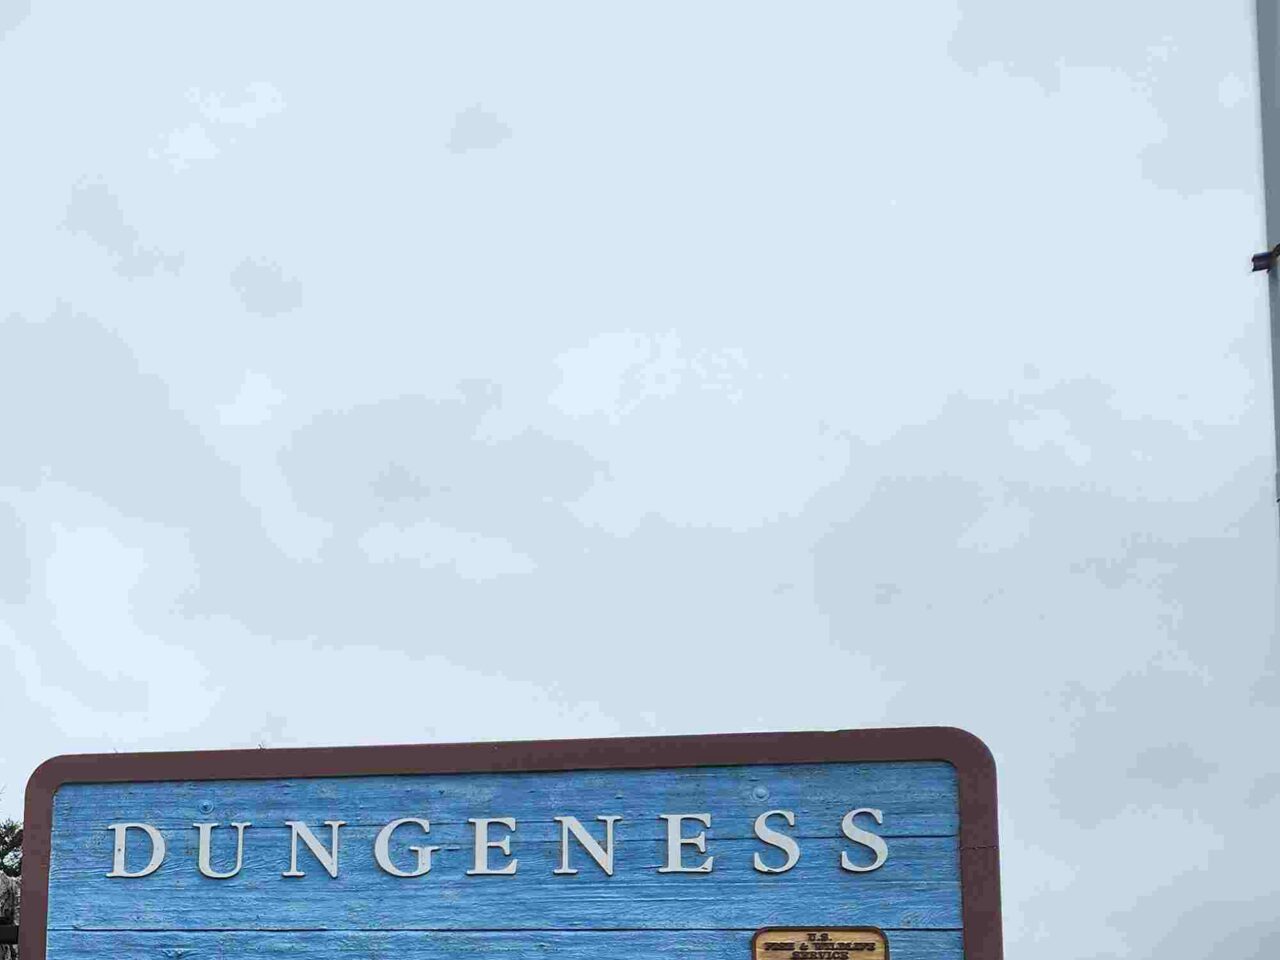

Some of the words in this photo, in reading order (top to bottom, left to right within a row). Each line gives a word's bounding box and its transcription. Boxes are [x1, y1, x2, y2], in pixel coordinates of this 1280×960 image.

[106, 807, 888, 880] DUNGENESS
[807, 932, 832, 942] U.S.
[790, 951, 849, 960] SERVICE
